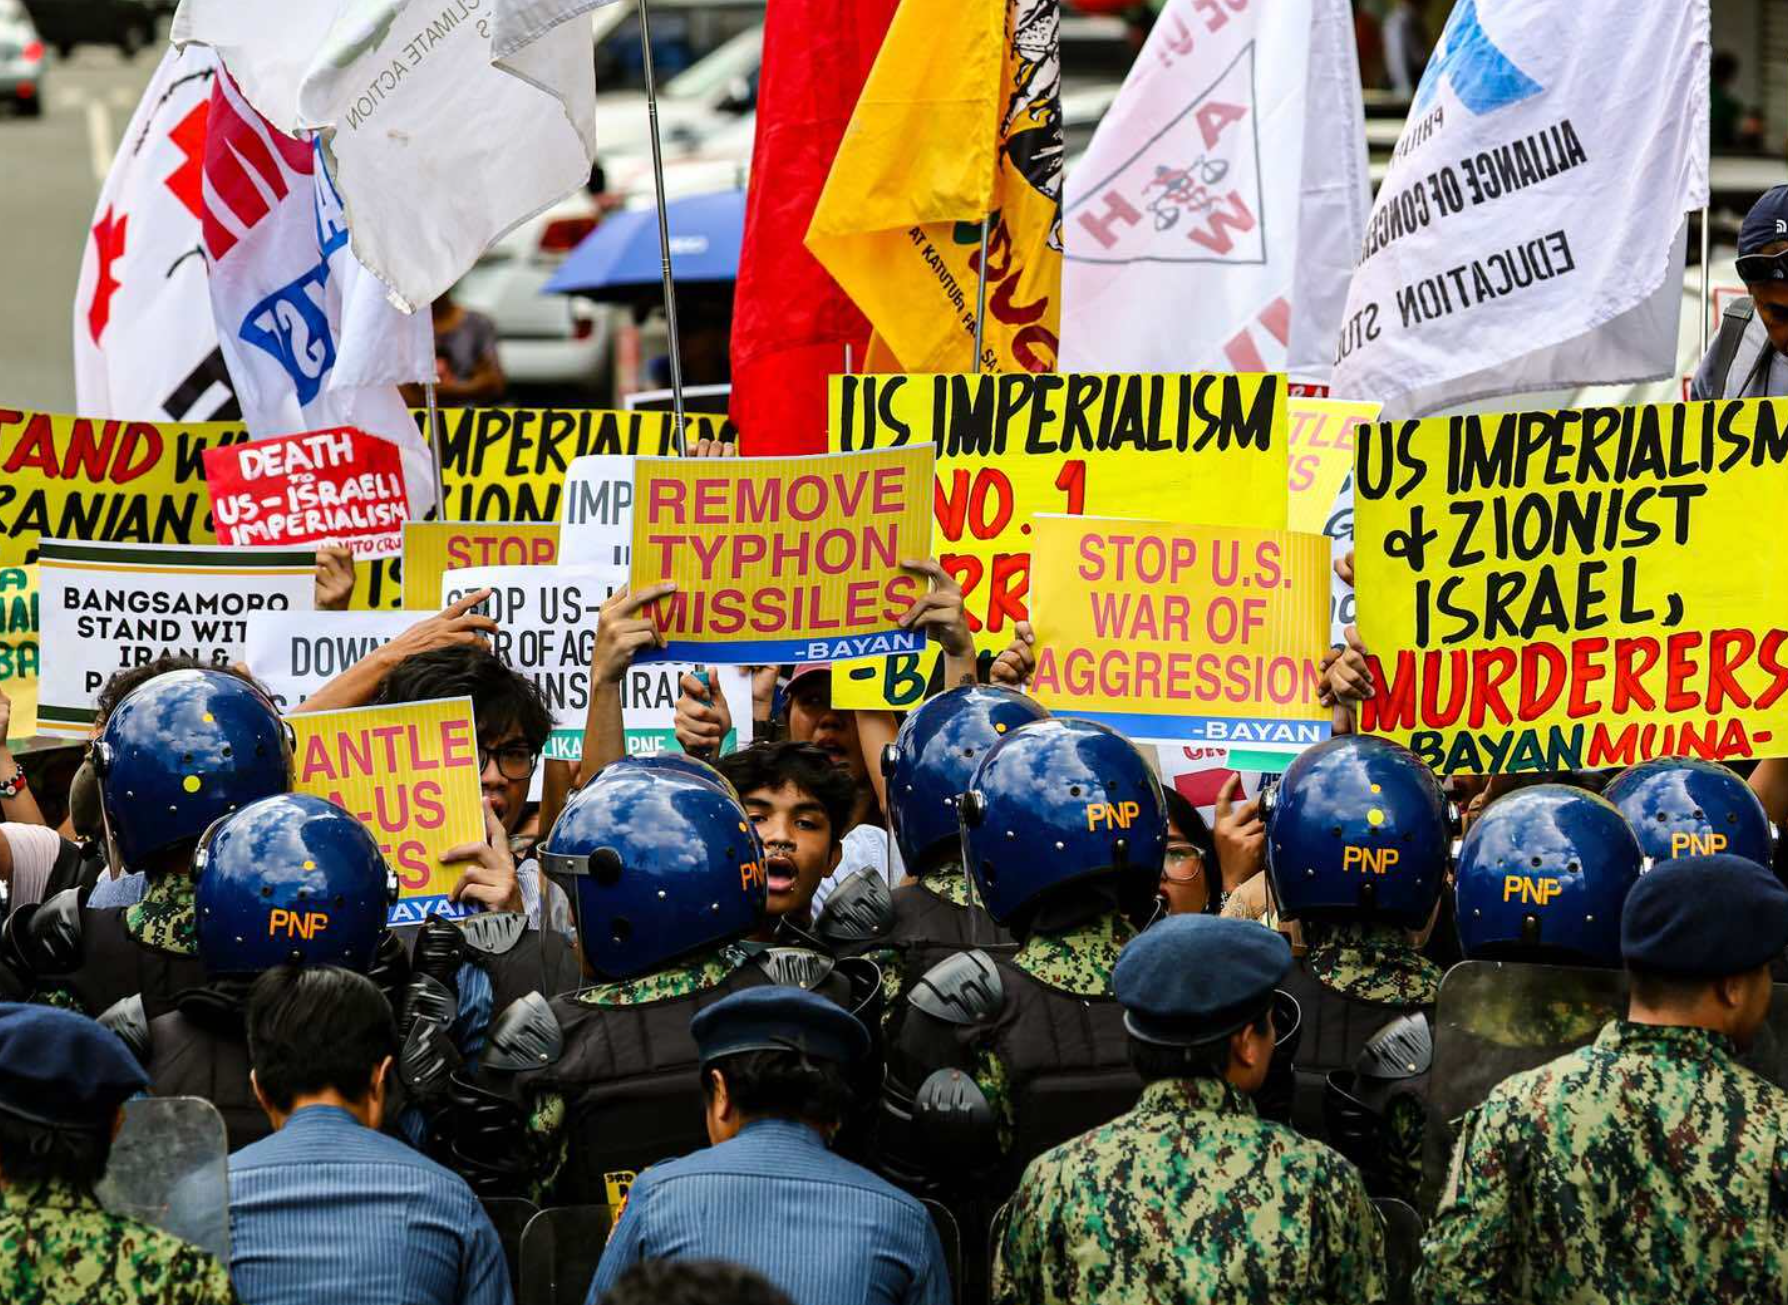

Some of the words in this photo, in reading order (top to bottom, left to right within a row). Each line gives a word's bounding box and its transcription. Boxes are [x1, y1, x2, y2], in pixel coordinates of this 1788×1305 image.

[840, 374, 912, 453] US
[933, 373, 1277, 459] IMPERIALISM
[238, 433, 354, 481] DEATH
[1357, 420, 1428, 500] US
[1447, 400, 1788, 495] IMPERIALISM
[648, 467, 906, 525] REMOVE
[1055, 460, 1087, 516] 1
[229, 501, 410, 547] IMPERIALISM
[1448, 483, 1708, 569] ZIONIST
[447, 536, 555, 569] STOP
[648, 524, 899, 581] TYPHON
[1078, 533, 1197, 584] STOP
[1211, 540, 1292, 589] U.S.
[63, 587, 289, 616] BANGSAMORO
[641, 576, 918, 635] MISSILES
[1090, 592, 1190, 641] WAR
[1206, 596, 1267, 645] OF
[1416, 556, 1685, 649] ISRAEL,
[77, 616, 181, 642] STAND
[191, 620, 247, 643] WIT
[519, 630, 555, 668] OF
[1032, 647, 1323, 705] AGGRESSION
[1361, 628, 1788, 733] MURDERERS
[1087, 800, 1141, 833] PNP
[1343, 845, 1400, 875] PNP
[1671, 832, 1728, 859] PNP
[1503, 874, 1563, 906] PNP
[268, 908, 329, 940] PNP
